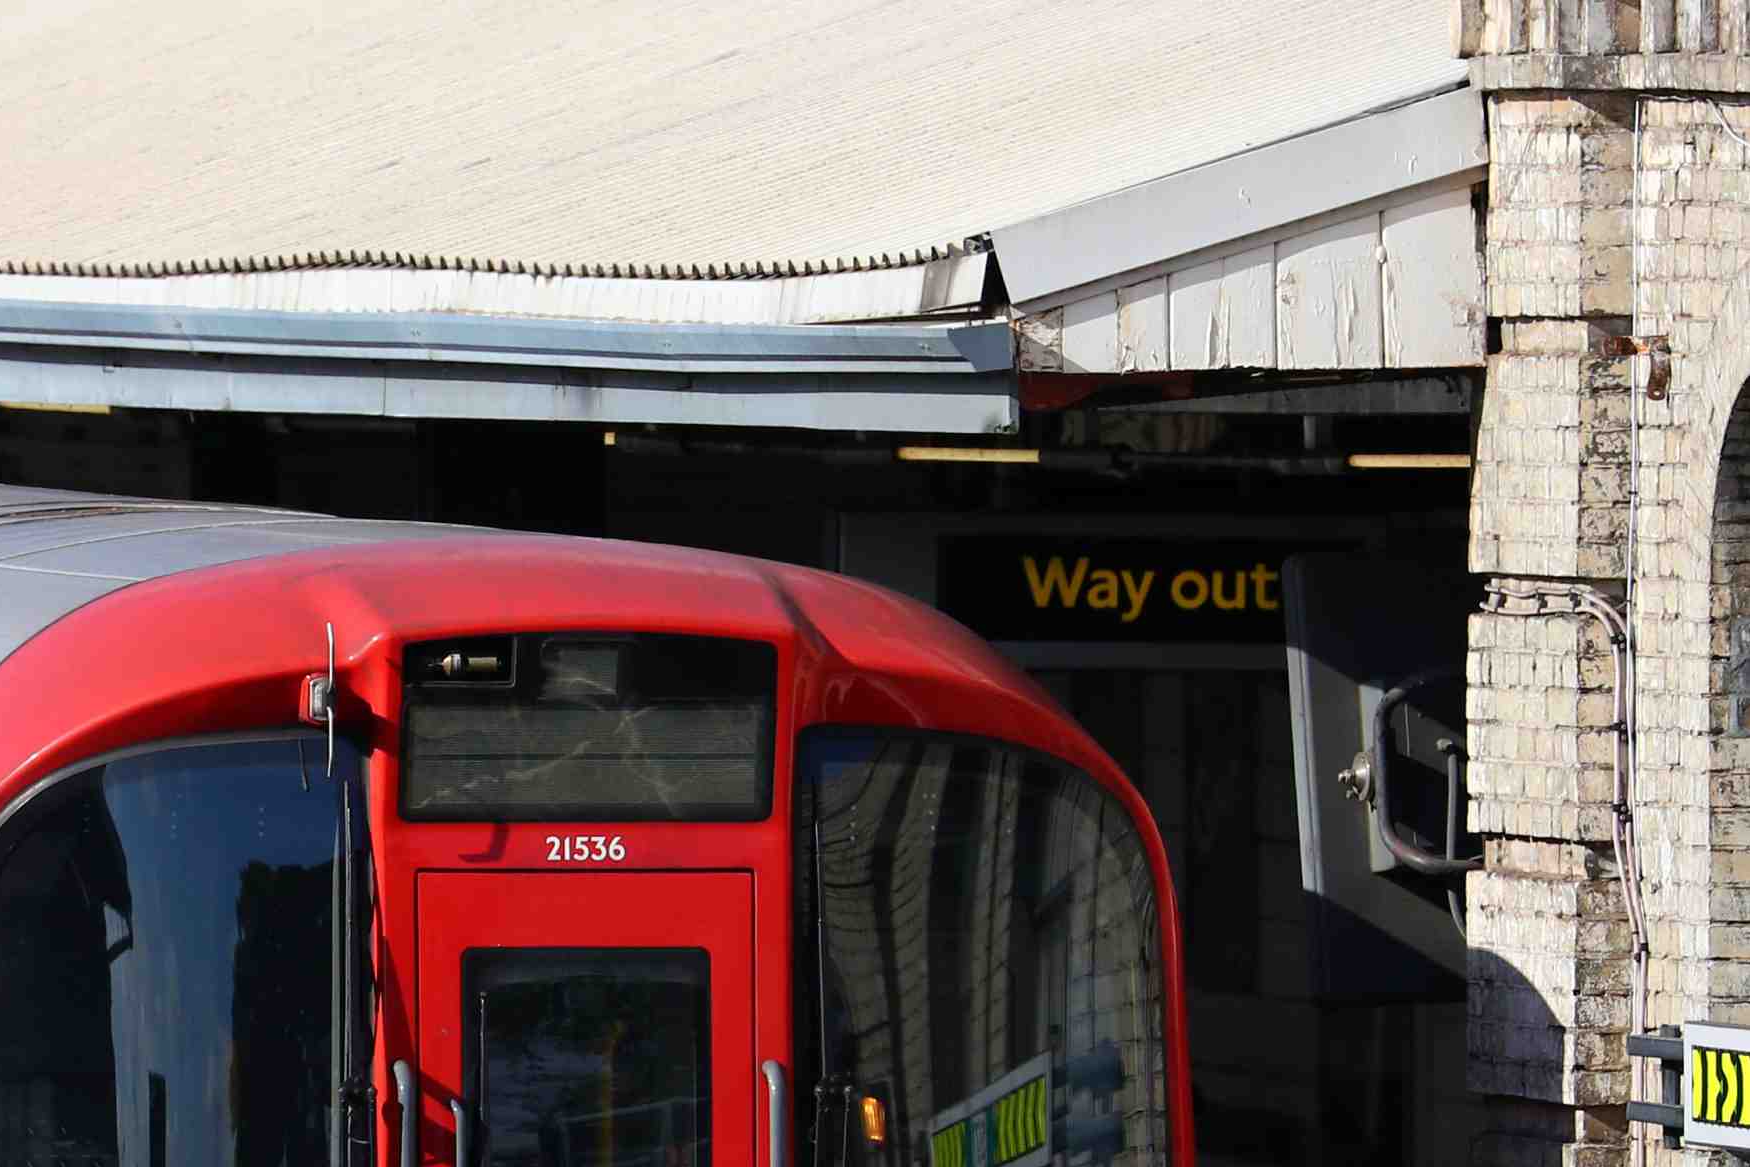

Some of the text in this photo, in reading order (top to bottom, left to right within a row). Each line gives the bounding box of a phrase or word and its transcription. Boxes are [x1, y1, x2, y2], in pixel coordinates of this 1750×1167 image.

[1022, 556, 1279, 622] Way out
[546, 836, 626, 861] 21536
